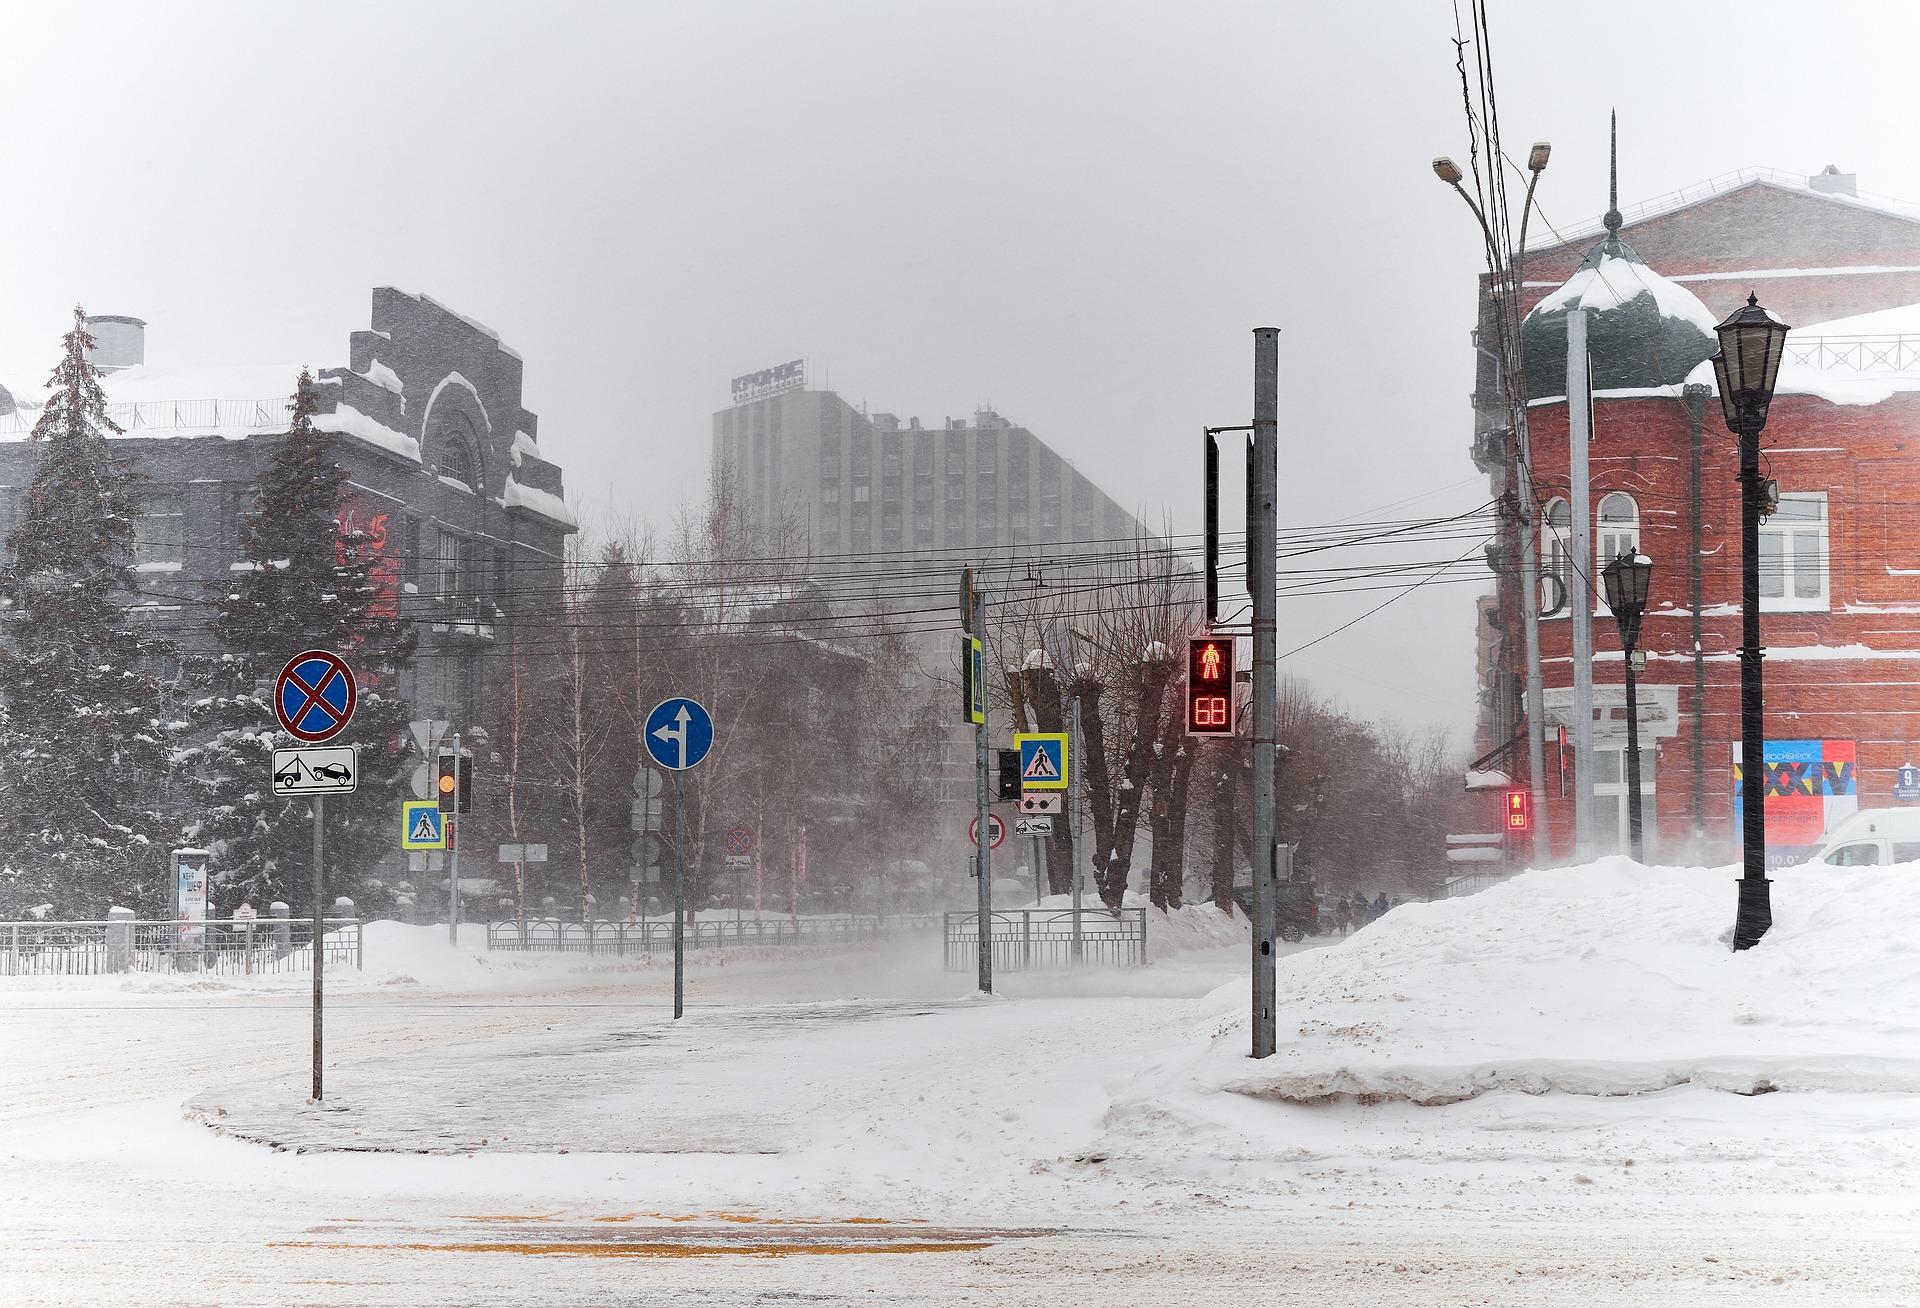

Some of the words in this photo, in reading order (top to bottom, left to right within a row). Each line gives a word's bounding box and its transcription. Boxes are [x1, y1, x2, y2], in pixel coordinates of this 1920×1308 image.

[1195, 697, 1226, 725] 68
[1904, 770, 1913, 786] 9
[187, 880, 203, 892] ШЕФ
